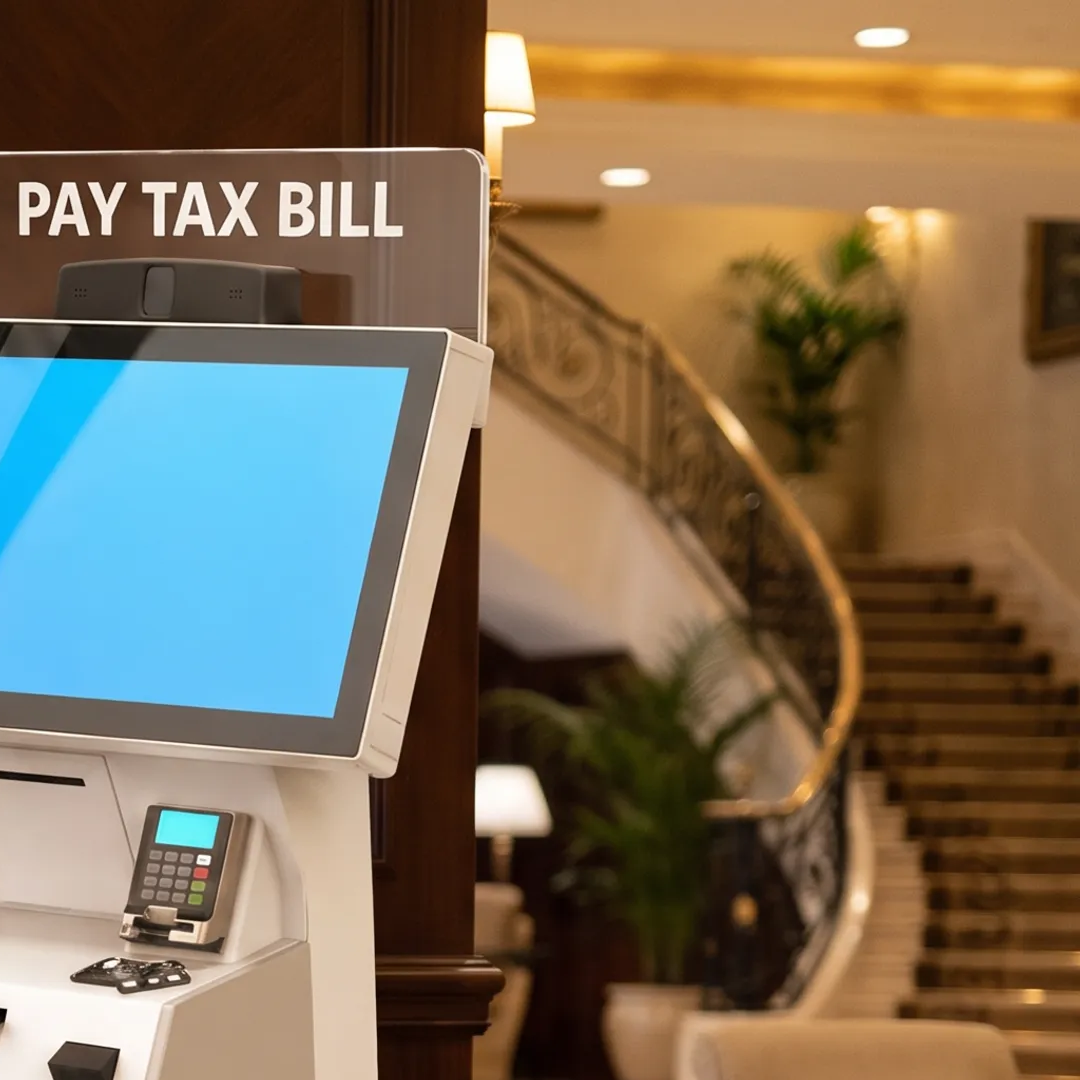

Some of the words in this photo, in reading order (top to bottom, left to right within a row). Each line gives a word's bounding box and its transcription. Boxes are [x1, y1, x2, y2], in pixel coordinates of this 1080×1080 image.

[18, 181, 127, 236] PAY
[141, 181, 259, 237] TAX
[278, 181, 404, 238] BILL
